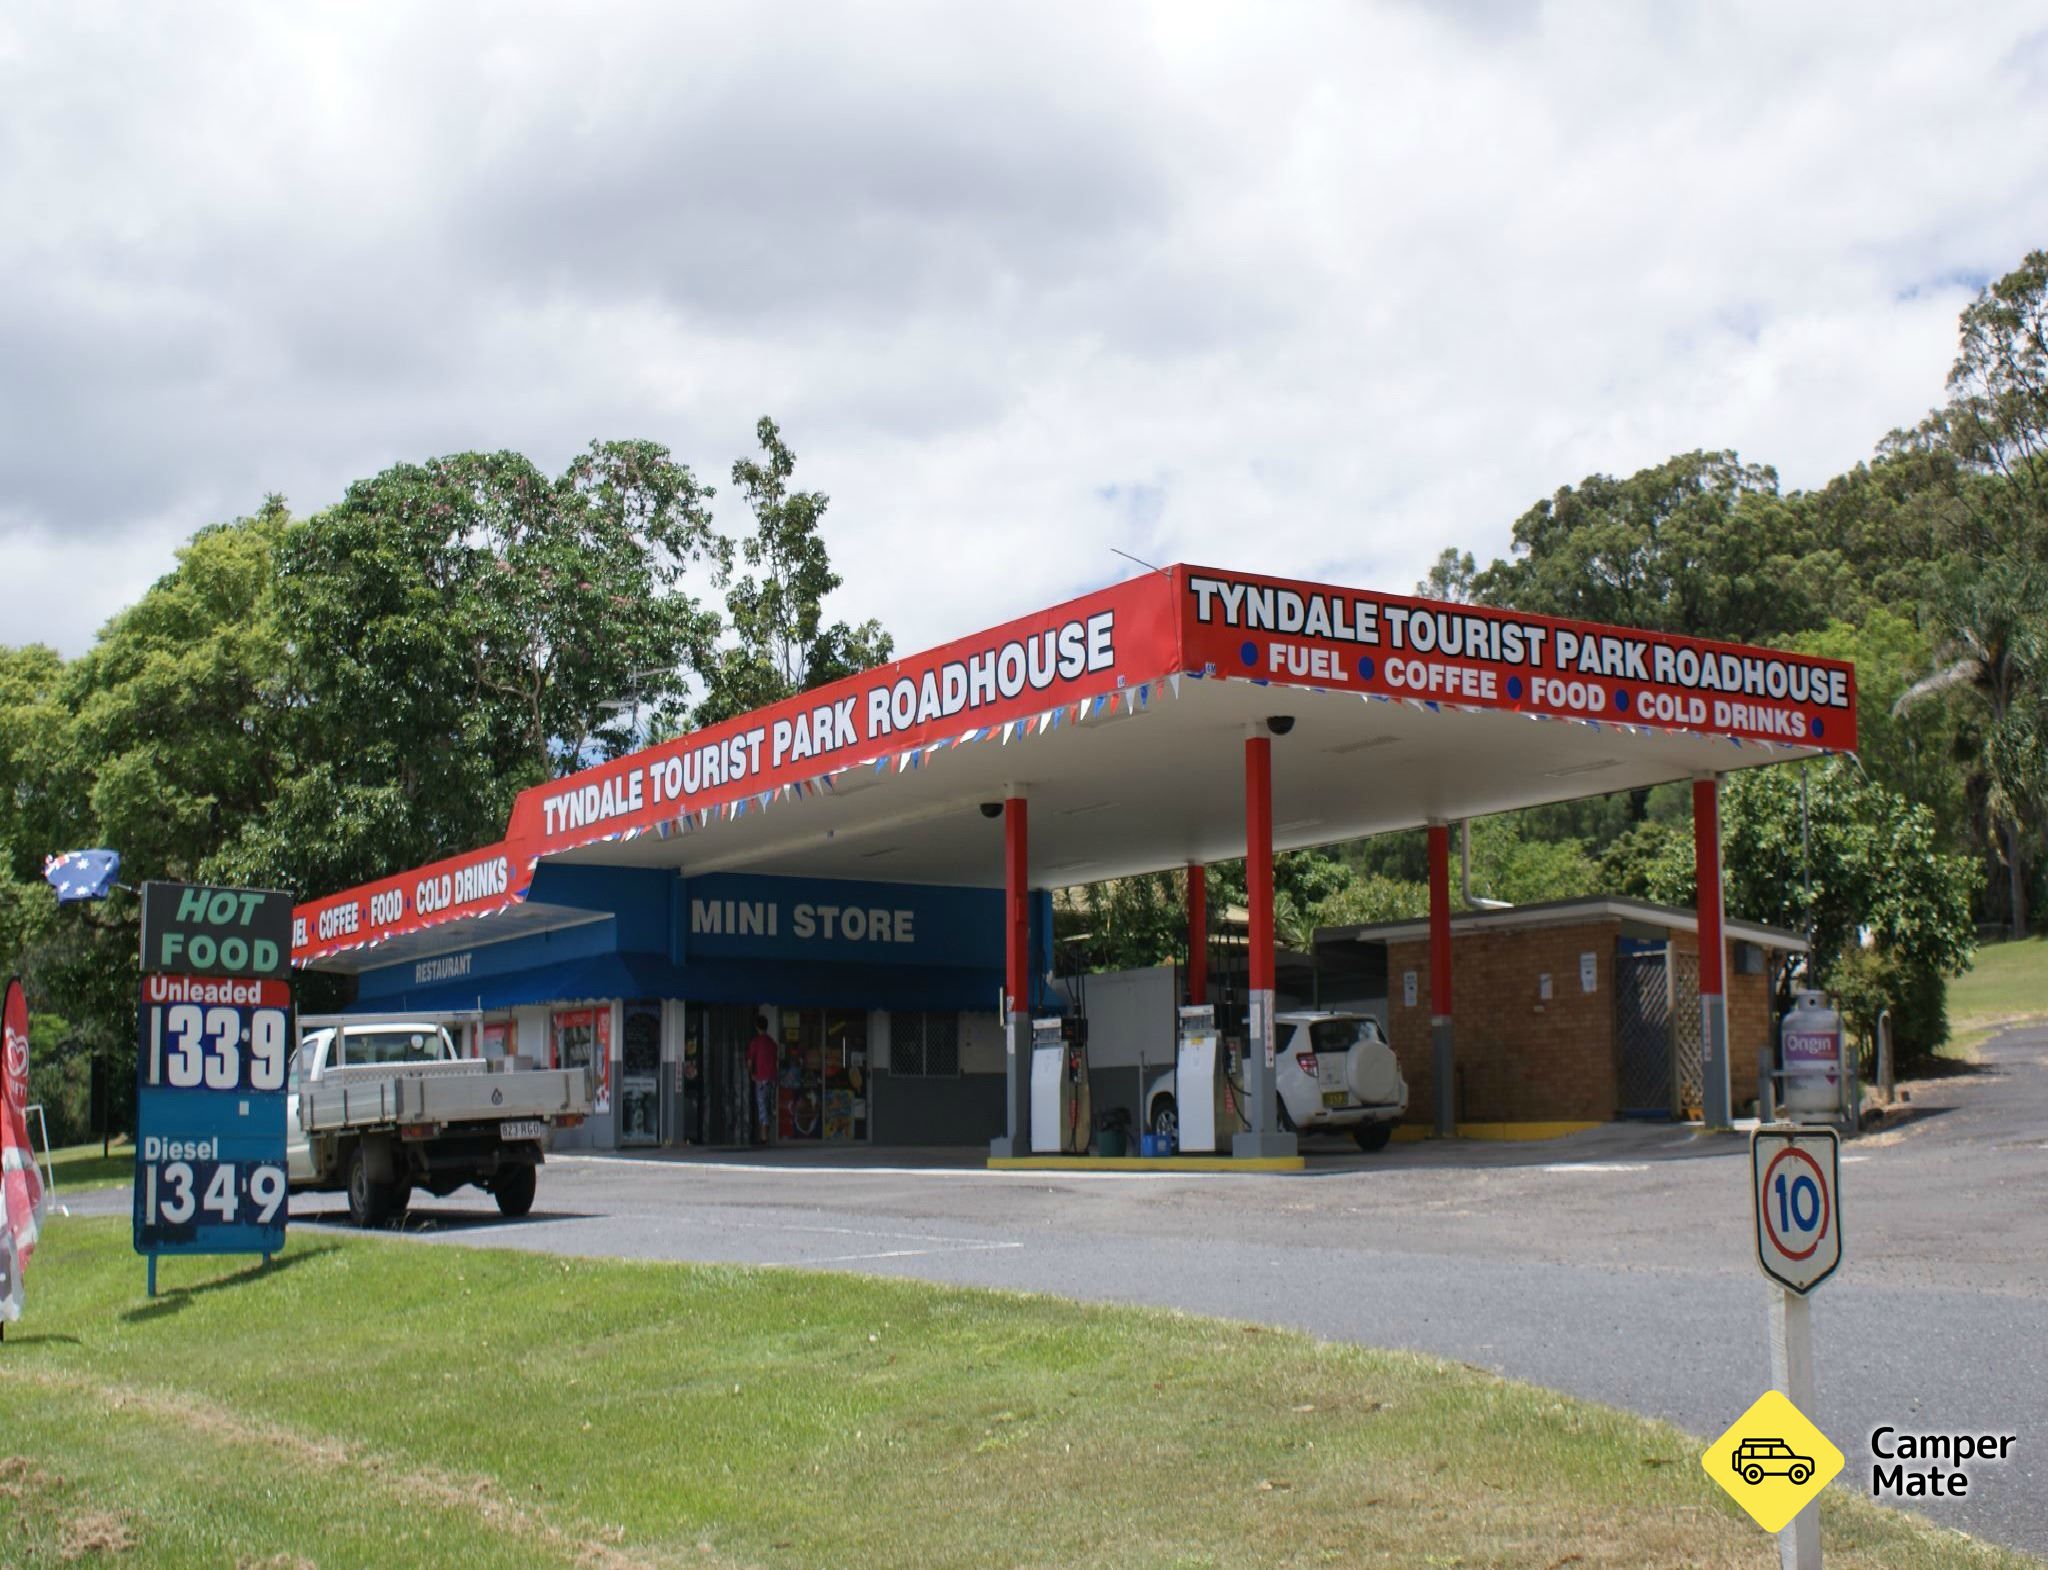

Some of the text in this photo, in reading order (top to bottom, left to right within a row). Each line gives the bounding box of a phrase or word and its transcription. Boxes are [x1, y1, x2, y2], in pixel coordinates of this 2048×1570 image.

[1189, 575, 1850, 708] TYNDALE TOURIST PARK ROADHOUSE
[1268, 643, 1806, 738] FUEL COFFEE FOOD COLD DRINKS
[543, 609, 1115, 835] TYNDALE TOURIST PARK ROADHOUSE
[176, 887, 265, 926] HOT
[318, 902, 359, 940] COFFEE
[370, 889, 403, 927] FOOD
[416, 874, 451, 916] COLD
[455, 856, 508, 905] DRINKS
[691, 898, 914, 943] MINI STORE
[161, 933, 279, 972] FOOD
[415, 953, 472, 984] RESTAURANT
[150, 977, 261, 1004] Unleaded
[144, 1137, 218, 1160] Diesel
[1775, 1173, 1821, 1233] 10
